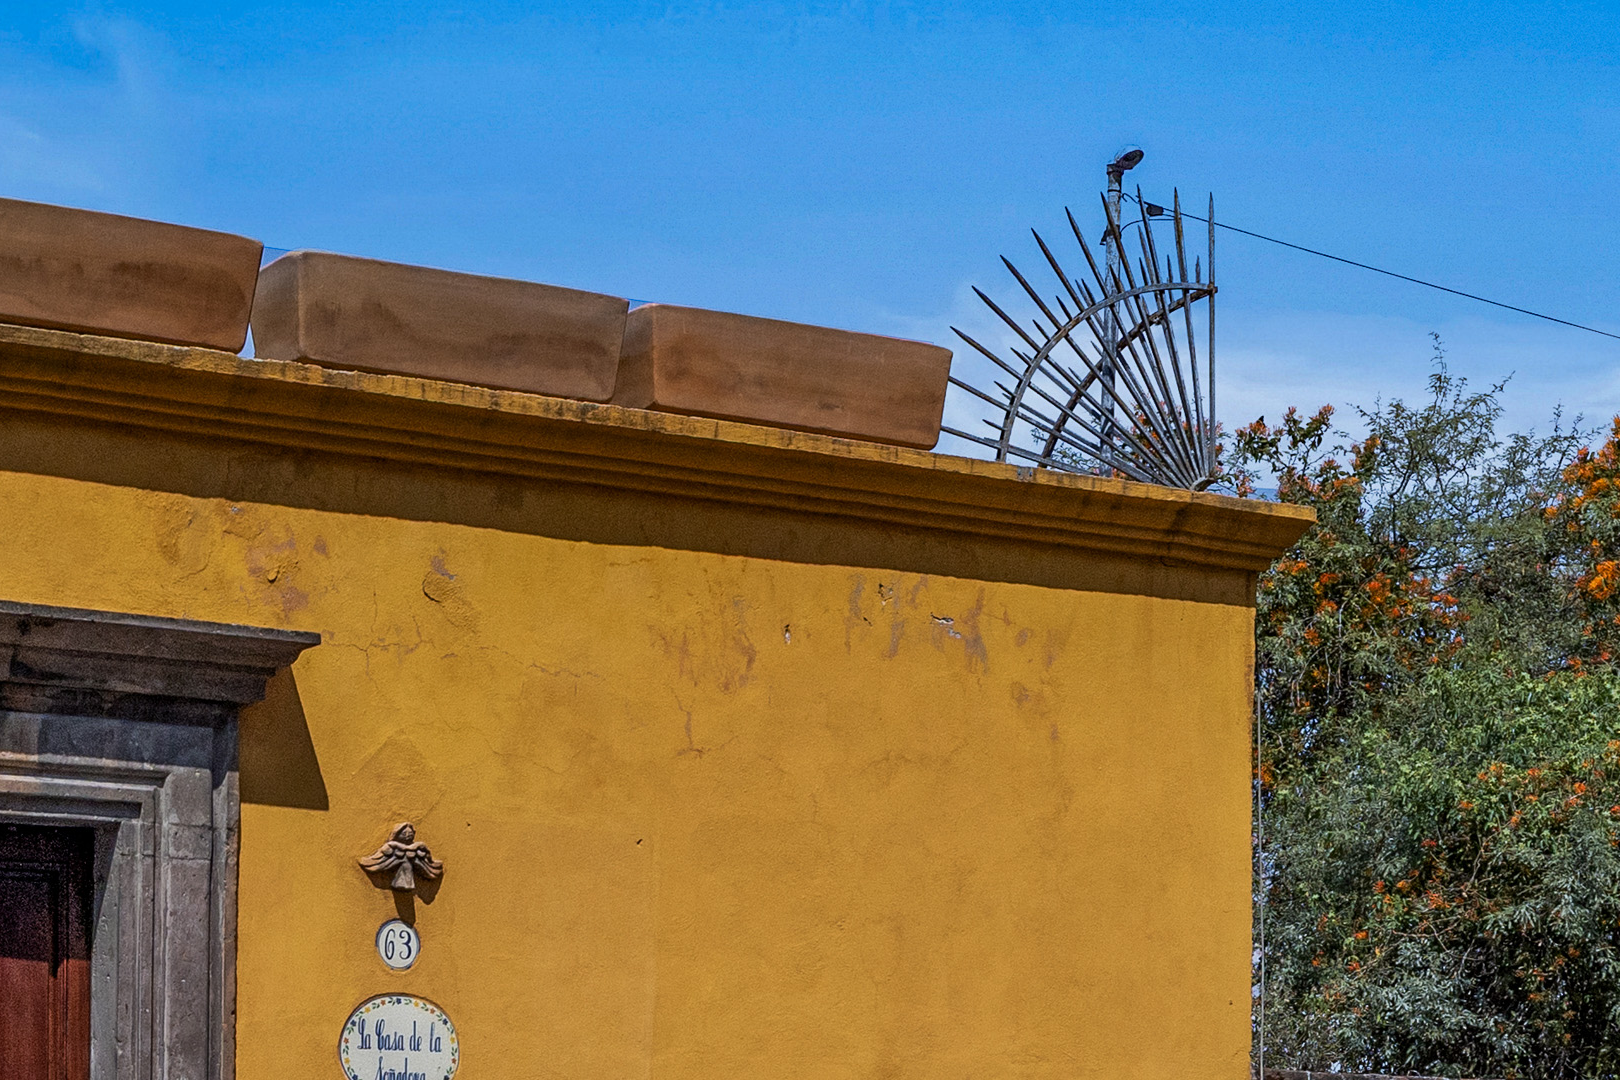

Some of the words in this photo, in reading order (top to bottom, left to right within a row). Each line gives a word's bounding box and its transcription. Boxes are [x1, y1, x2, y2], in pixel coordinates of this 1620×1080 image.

[384, 928, 412, 960] 63
[357, 1018, 372, 1050] La
[375, 1018, 405, 1052] Casa
[409, 1020, 423, 1052] de
[429, 1021, 442, 1053] la
